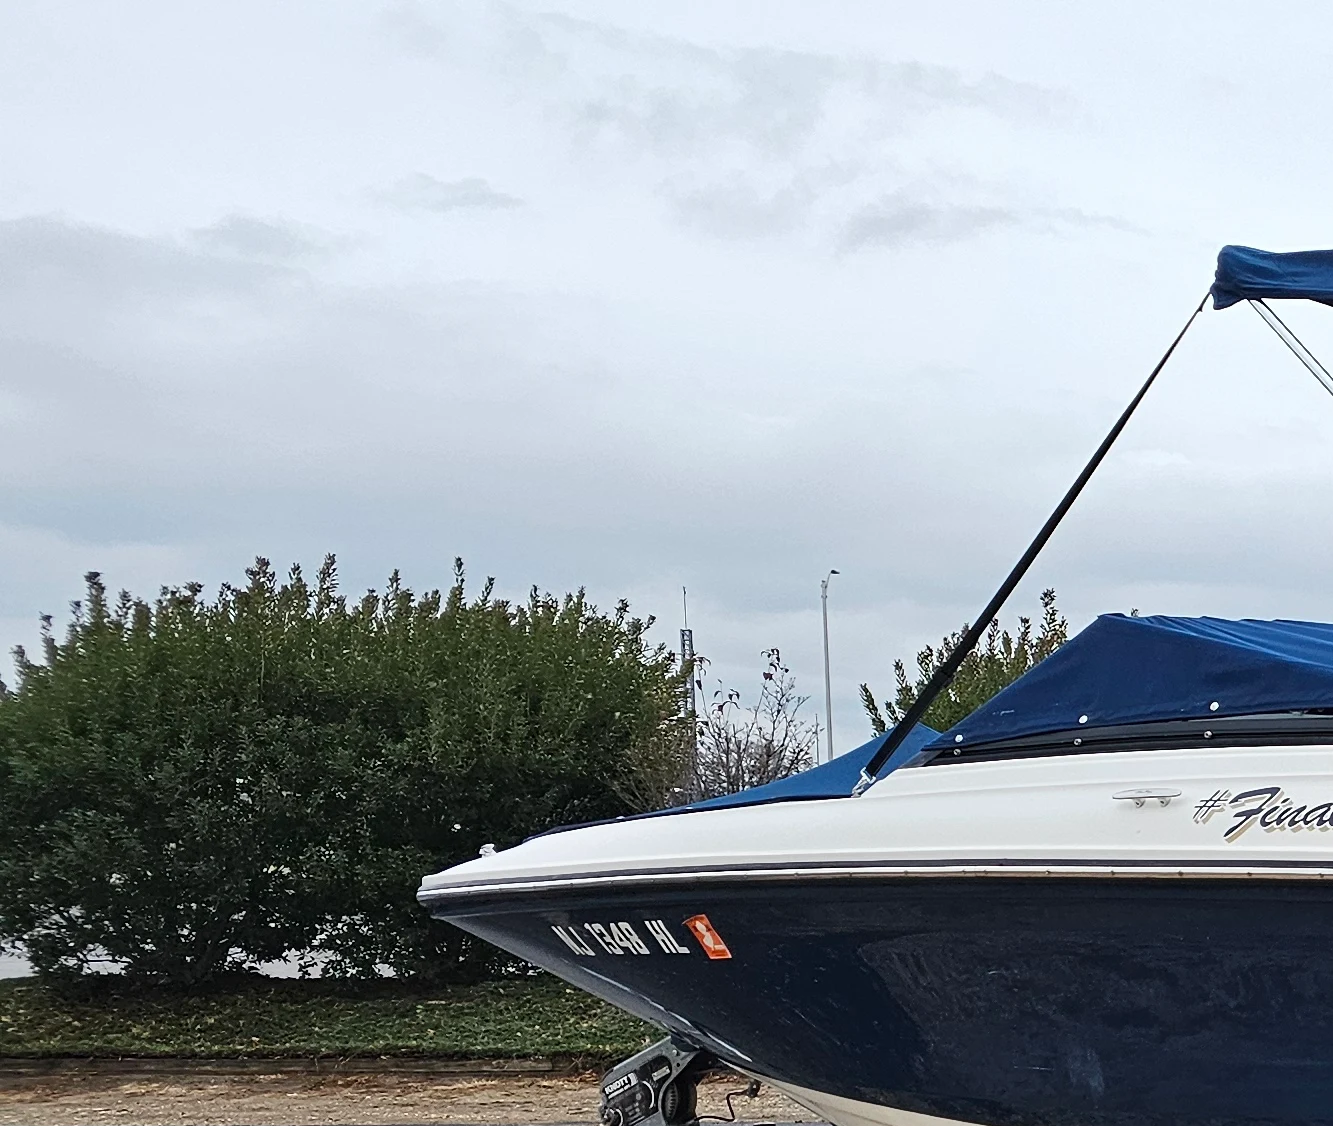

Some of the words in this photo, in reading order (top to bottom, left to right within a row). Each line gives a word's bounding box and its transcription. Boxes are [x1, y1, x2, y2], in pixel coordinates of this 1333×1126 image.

[551, 926, 596, 956] NJ
[584, 922, 650, 955] 1348
[644, 919, 691, 954] HL
